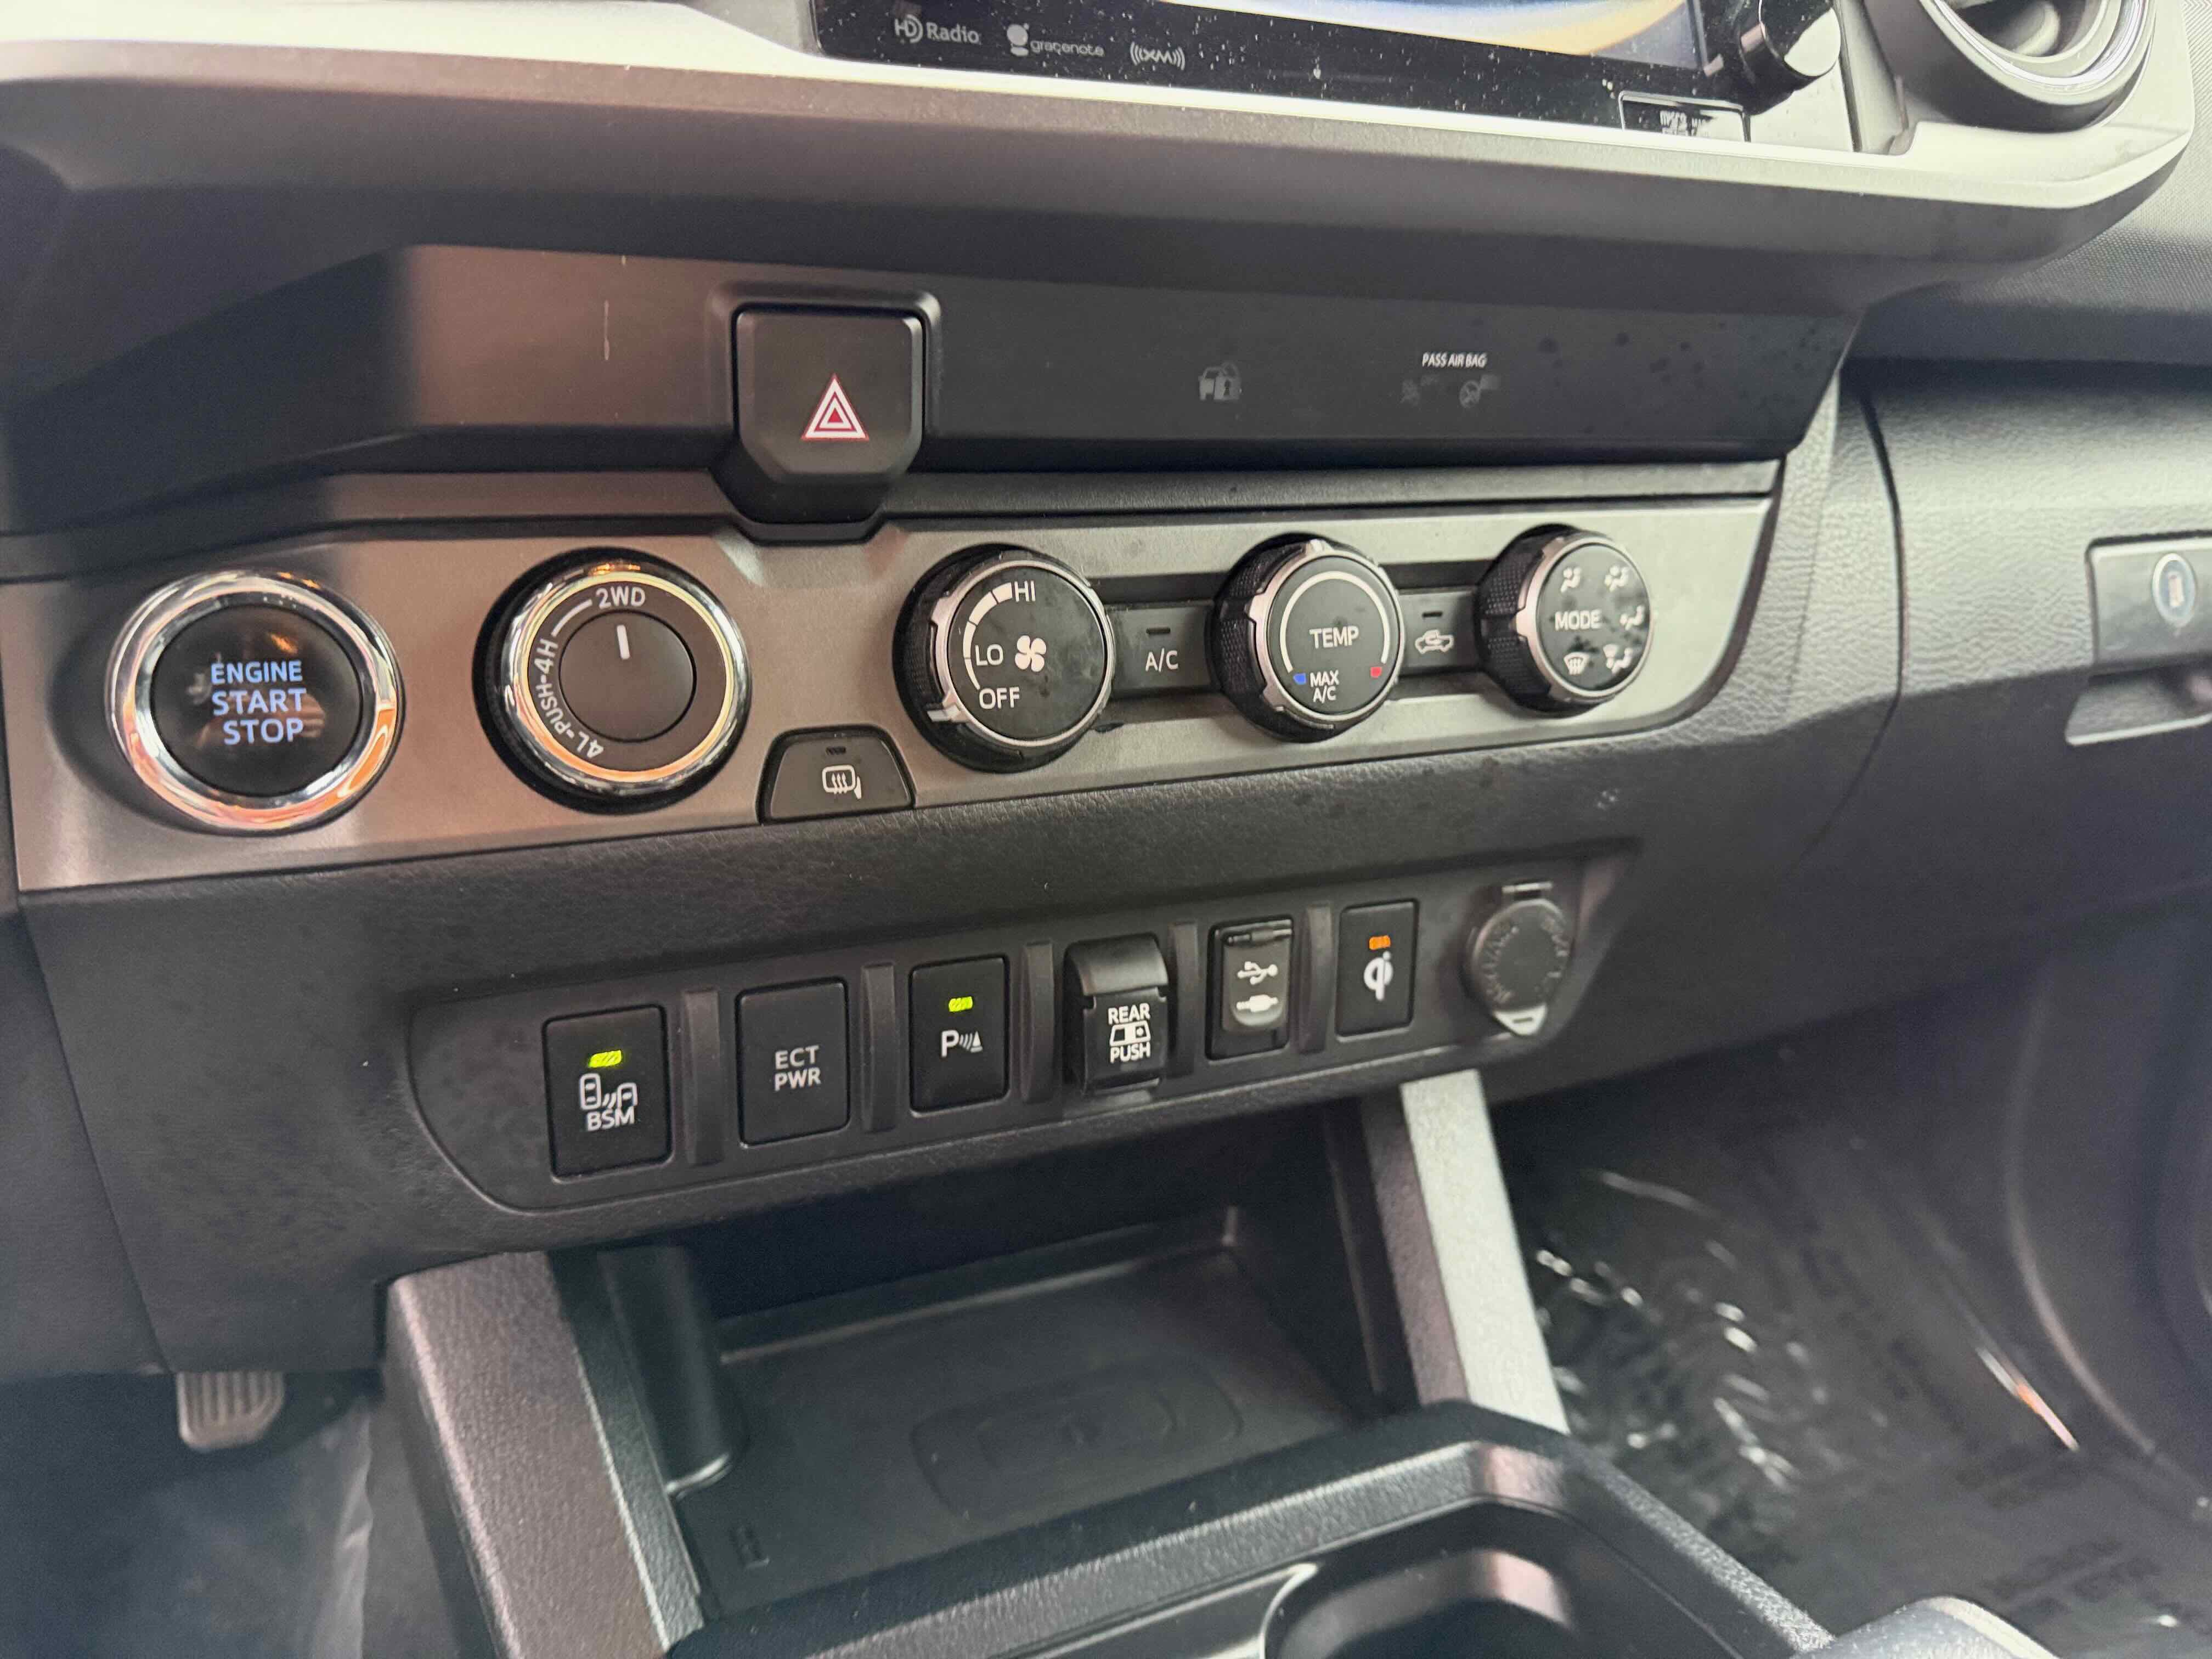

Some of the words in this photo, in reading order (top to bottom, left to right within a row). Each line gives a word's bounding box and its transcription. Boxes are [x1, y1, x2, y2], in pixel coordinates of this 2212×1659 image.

[926, 22, 980, 44] Radio
[1422, 352, 1447, 368] PASS
[1448, 353, 1465, 368] AIR
[1465, 352, 1487, 368] BAG
[596, 586, 645, 610] 2WD
[1014, 580, 1036, 602] HI
[1554, 610, 1602, 631] MODE
[1309, 625, 1359, 648] TEMP
[975, 644, 1003, 666] LO
[1145, 648, 1178, 672] A/C
[211, 660, 303, 685] ENGINE
[1310, 670, 1339, 687] MAX
[211, 687, 306, 716] START
[979, 686, 1020, 709] OFF
[1313, 686, 1336, 704] A/C
[223, 718, 303, 745] STOP
[1108, 1002, 1150, 1025] REAR
[775, 1045, 819, 1070] ECT
[1110, 1042, 1150, 1063] PUSH
[775, 1067, 821, 1092] PWR
[586, 1107, 635, 1132] BSM
